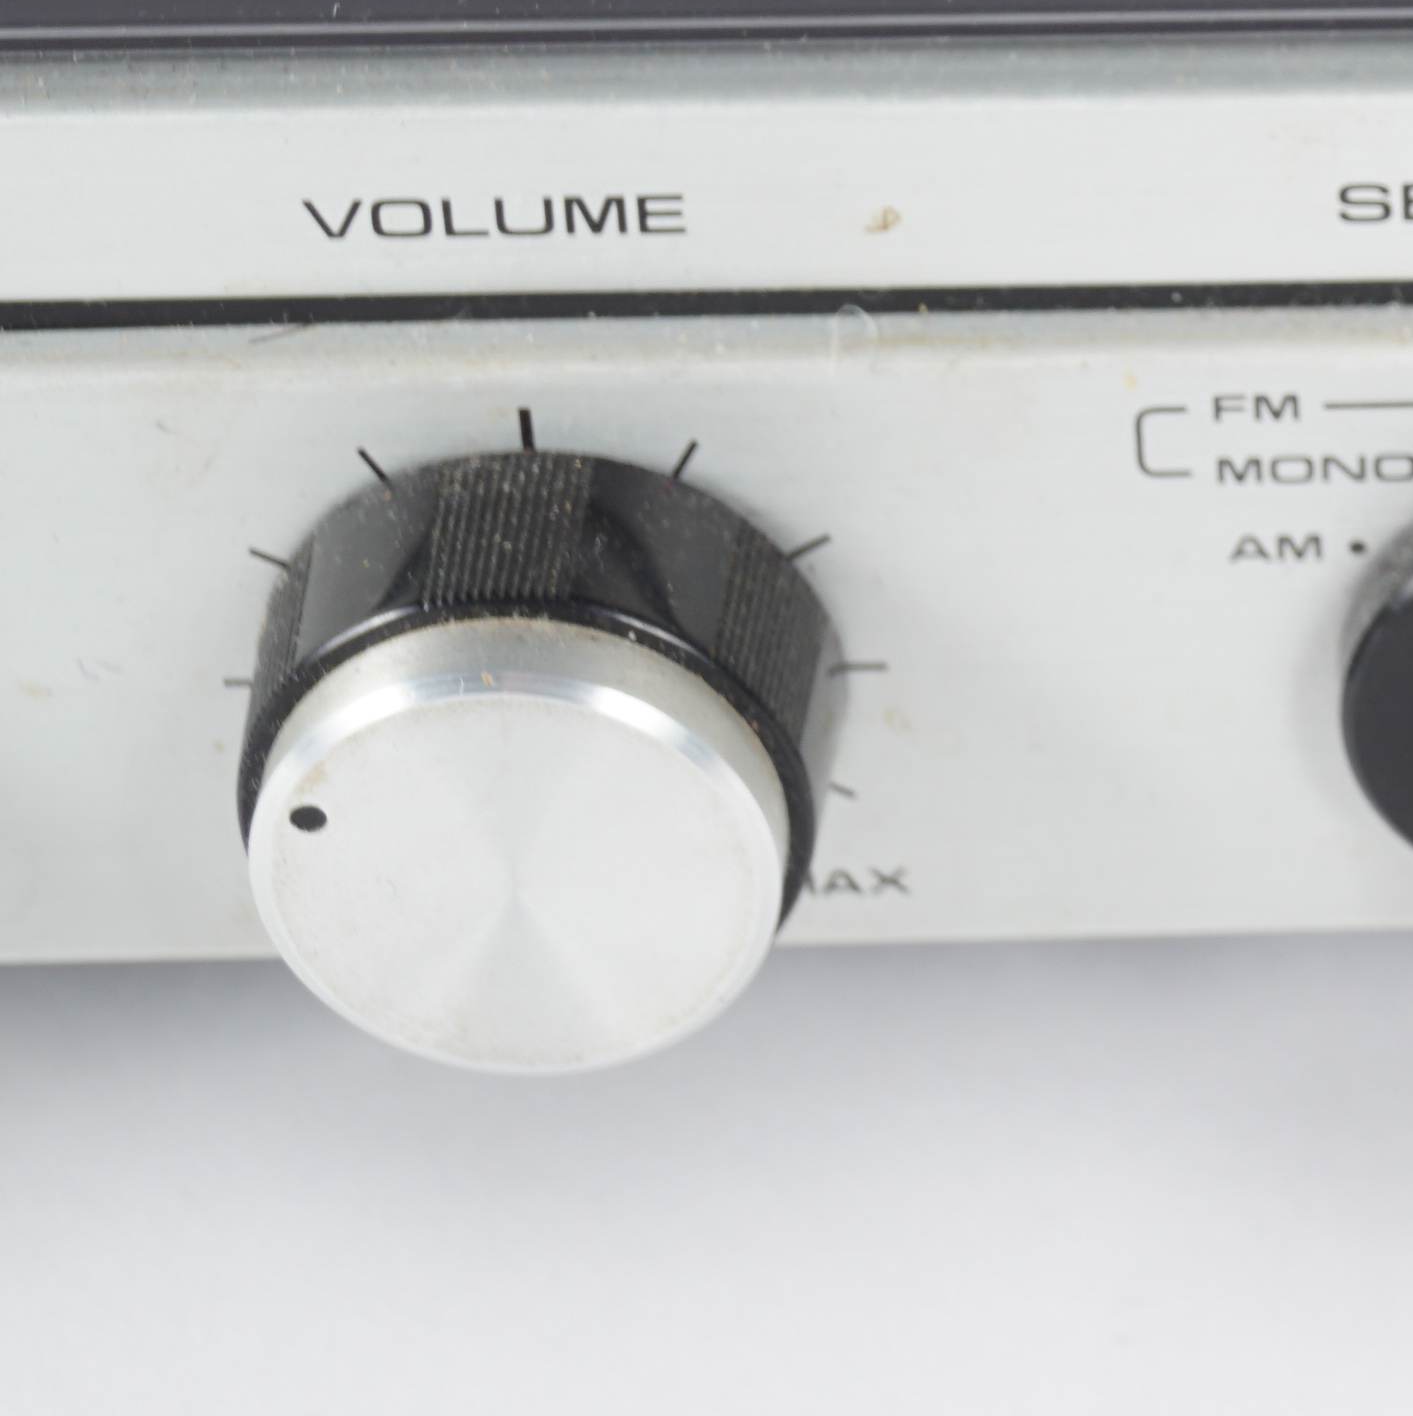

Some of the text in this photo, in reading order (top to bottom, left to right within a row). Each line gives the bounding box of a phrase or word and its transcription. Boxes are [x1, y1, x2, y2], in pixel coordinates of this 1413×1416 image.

[301, 193, 688, 239] VOLUME
[1212, 392, 1302, 422] FM
[1228, 532, 1325, 563] AM
[804, 864, 911, 896] AX
